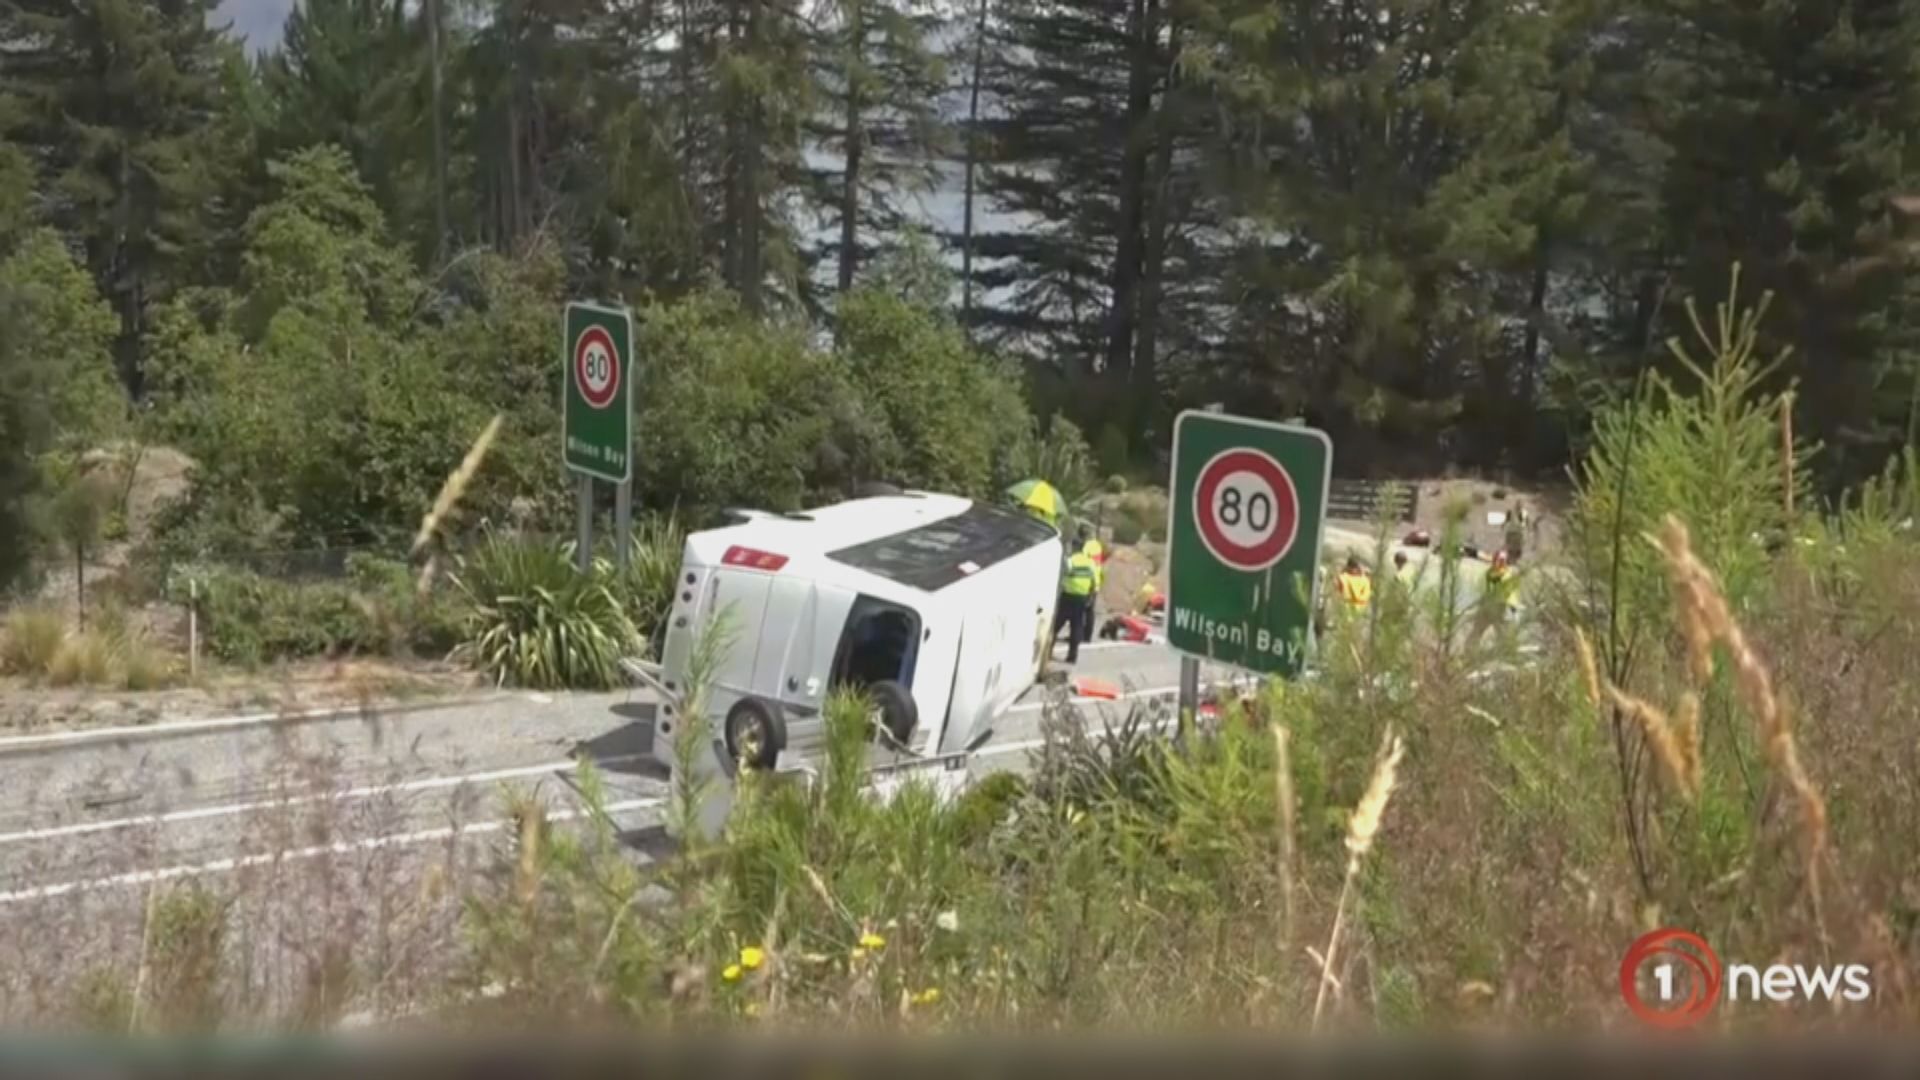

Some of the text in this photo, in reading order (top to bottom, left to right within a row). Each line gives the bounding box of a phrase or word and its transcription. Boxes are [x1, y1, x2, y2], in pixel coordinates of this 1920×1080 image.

[586, 352, 608, 382] 80
[1219, 487, 1271, 532] 80
[1175, 607, 1301, 665] Wilson Bay
